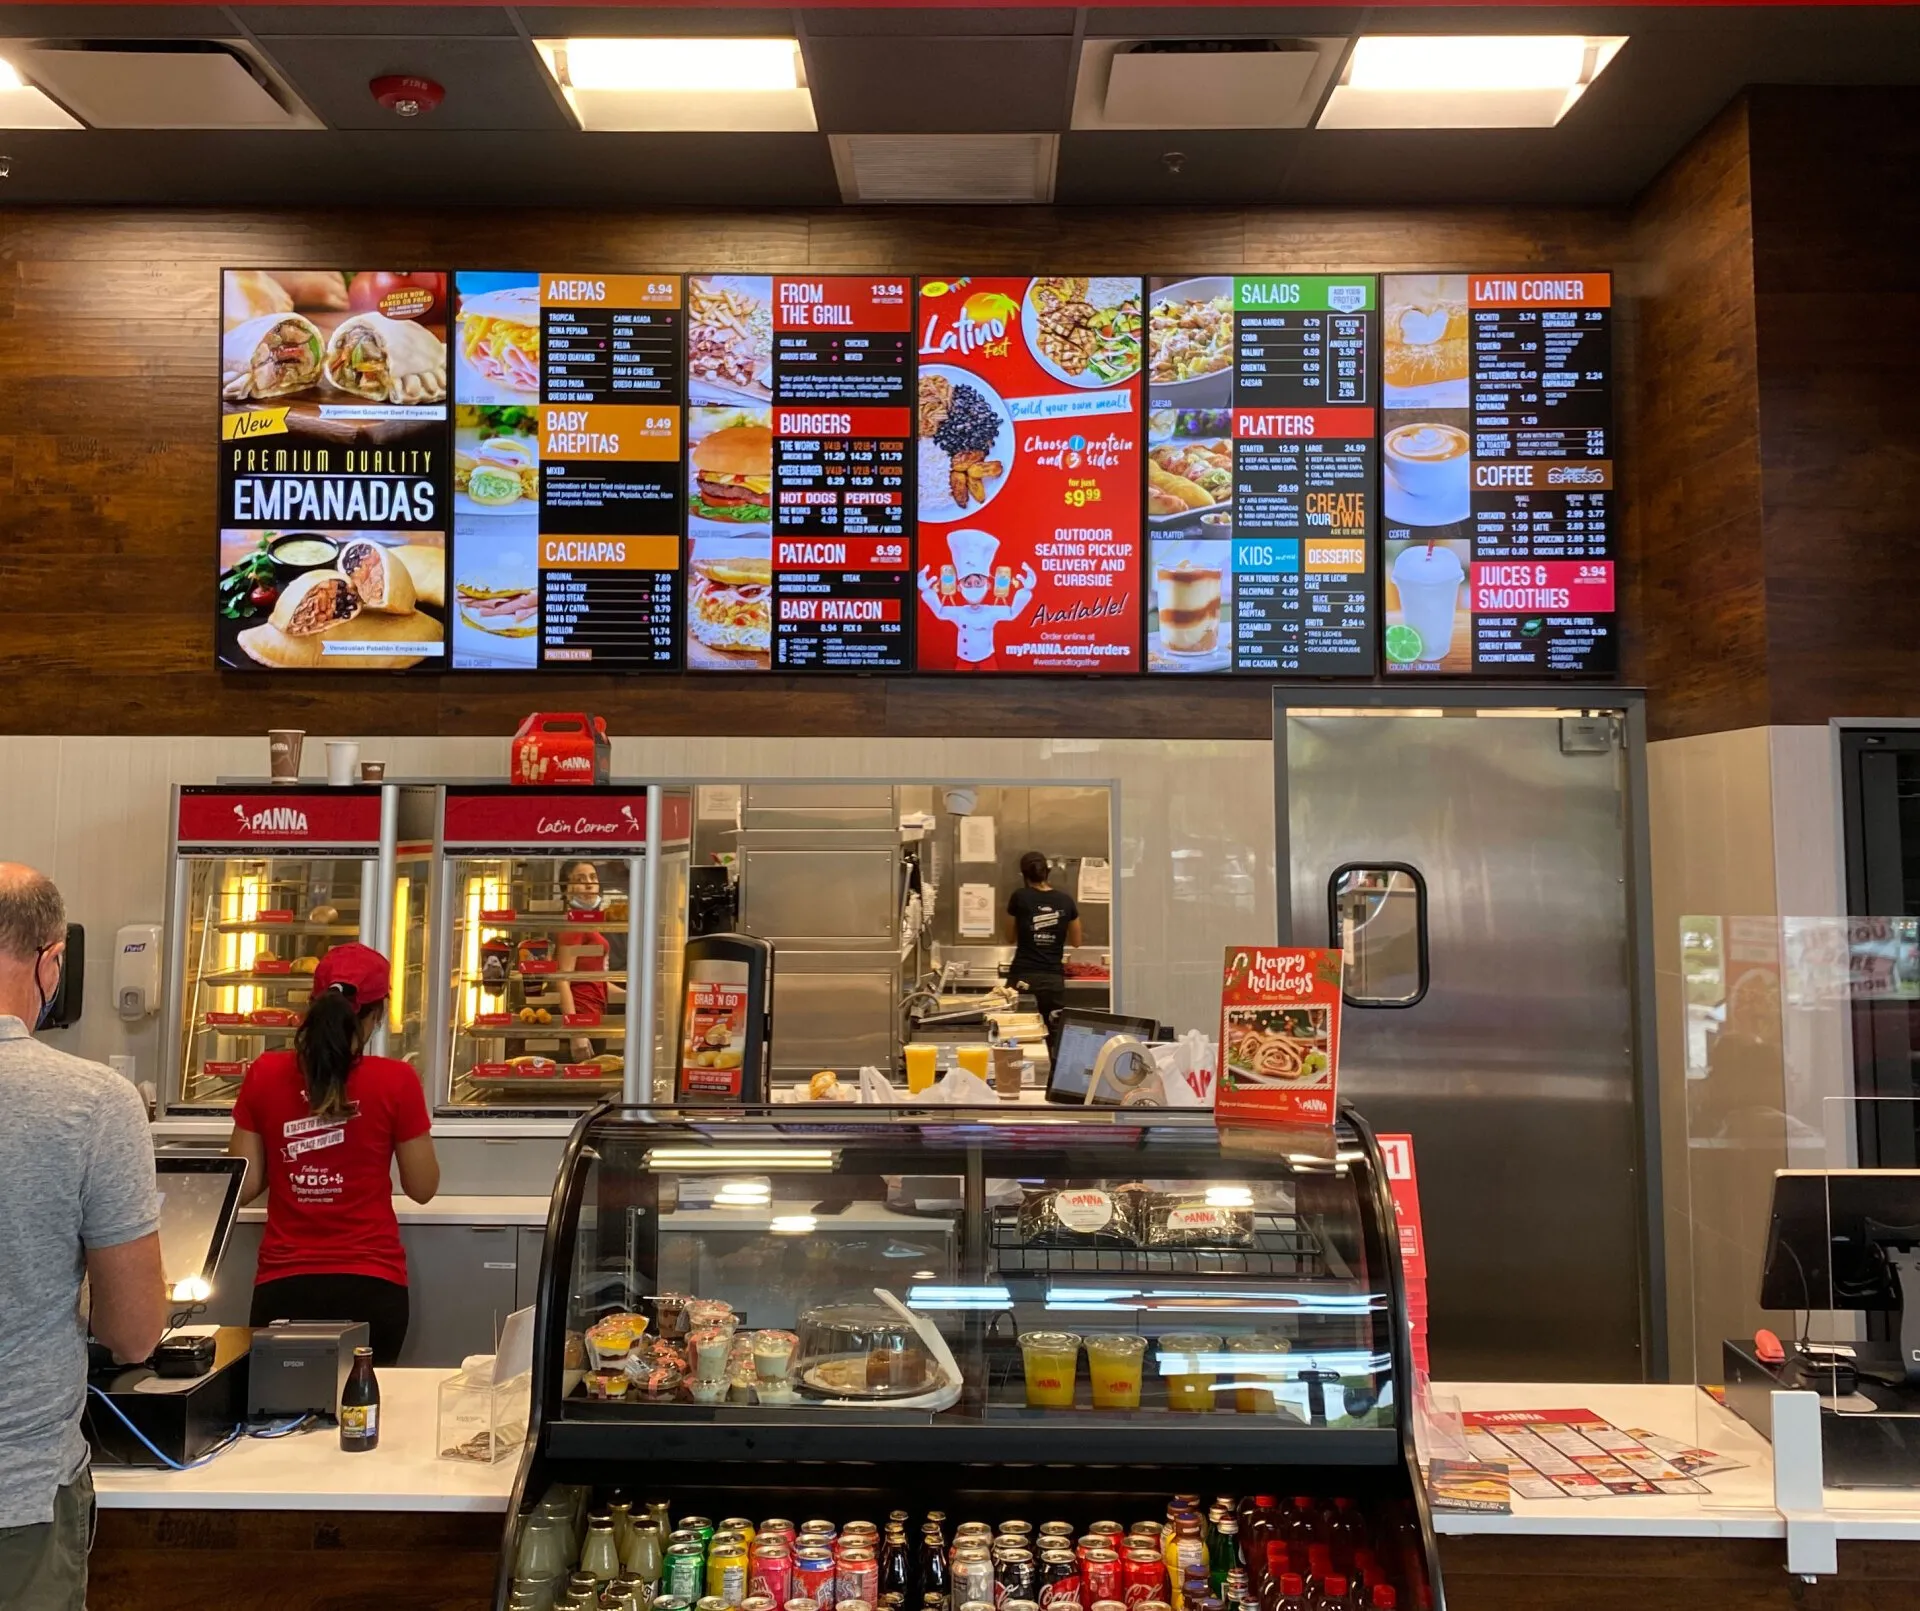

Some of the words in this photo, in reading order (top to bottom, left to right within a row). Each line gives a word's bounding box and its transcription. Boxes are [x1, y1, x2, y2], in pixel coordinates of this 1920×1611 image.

[548, 280, 605, 300] AREPAS
[647, 283, 673, 294] 6.94
[780, 283, 824, 304] FROM
[871, 284, 903, 296] 13.94
[1241, 283, 1300, 303] SALADS
[1475, 281, 1517, 301] LATIN
[1521, 280, 1584, 300] CORNER
[1333, 296, 1361, 304] PROTEIN
[548, 313, 575, 321] TROPICAL
[780, 304, 809, 325] THE
[812, 305, 854, 325] GRILL
[918, 307, 1005, 355] Latino
[1338, 327, 1355, 335] 2.50
[548, 340, 569, 348] PERICO
[984, 338, 1013, 358] Fest
[1338, 348, 1355, 356] 3.50
[1339, 381, 1354, 389] TUNA
[1338, 389, 1355, 397] 2.50
[1011, 400, 1042, 417] Build
[1045, 404, 1067, 415] your
[1072, 403, 1092, 411] own
[1096, 395, 1127, 409] meal!
[405, 409, 438, 417] Empanada
[233, 411, 273, 439] New
[547, 411, 588, 431] BABY
[646, 418, 671, 429] 8.49
[780, 413, 851, 434] BURGERS
[1239, 415, 1314, 436] PLATTERS
[547, 433, 619, 454] AREPITAS
[780, 441, 793, 451] THE
[793, 441, 820, 451] WORKS
[1024, 435, 1069, 453] Choose
[1086, 432, 1133, 455] protein
[1239, 444, 1264, 453] STARTER
[1278, 444, 1300, 453] 12.99
[1344, 444, 1366, 453] 24.99
[234, 449, 329, 471] PREMIUM
[347, 450, 432, 473] QUALITY
[1037, 450, 1064, 470] and
[1069, 452, 1080, 469] 3
[1087, 450, 1119, 470] sides
[546, 466, 565, 475] MIXED
[1476, 466, 1533, 486] COFFEE
[1068, 478, 1079, 487] for
[1080, 478, 1096, 488] just
[1548, 473, 1604, 483] ESPRESSO
[1239, 485, 1252, 493] FULL
[1277, 484, 1299, 493] 29.99
[234, 479, 434, 521] EMPANADAS
[780, 493, 802, 504] HOT
[805, 492, 837, 504] DOGS
[845, 493, 892, 504] PEPITOS
[1306, 493, 1364, 513] CREATE
[844, 507, 862, 516] STEAK
[1305, 513, 1331, 525] YOUR
[1330, 511, 1365, 528] OWN
[1389, 529, 1411, 538] COFFEE
[1533, 523, 1550, 532] LATTE
[1054, 528, 1112, 541] OUTDOOR
[1151, 531, 1162, 539] FULL
[1163, 531, 1184, 539] PLATTER
[546, 541, 626, 562] CACHAPAS
[779, 543, 846, 564] PATACON
[876, 545, 902, 556] 8.99
[1034, 543, 1085, 556] SEATING
[1239, 546, 1273, 566] KIDS
[1308, 549, 1362, 564] DESSERTS
[1042, 559, 1097, 571] DELIVERY
[1100, 559, 1125, 571] AND
[546, 572, 572, 580] ORIGINAL
[1478, 566, 1531, 586] JUICES
[1535, 565, 1547, 586] &
[1579, 566, 1606, 577] 3.94
[842, 574, 860, 582] STEAK
[1054, 574, 1113, 587] CURBSIDE
[1304, 582, 1320, 590] CAKE
[566, 594, 584, 602] STEAK
[1312, 595, 1328, 603] SLICE
[1479, 588, 1569, 609] SMOOTHIES
[781, 601, 818, 619] BABY
[821, 601, 882, 619] PATACON
[1030, 592, 1130, 628] Available!
[1312, 605, 1331, 613] WHOLE
[778, 624, 792, 632] PICK
[1282, 624, 1299, 632] 4.24
[1305, 619, 1323, 627] SHOTS
[1040, 633, 1061, 641] Order
[1063, 632, 1086, 641] online
[1087, 633, 1095, 641] at
[1005, 643, 1130, 657] myPANNA.com/orders
[1282, 645, 1299, 653] 4.24
[562, 756, 590, 769] PANNA
[252, 807, 308, 830] PANNA
[537, 817, 571, 834] Latin
[575, 817, 619, 834] Corner
[1255, 950, 1305, 974] happy
[1247, 970, 1314, 995] holidays
[695, 994, 714, 1006] GRAB
[725, 995, 738, 1007] GO
[1302, 1099, 1328, 1111] PANNA
[290, 1122, 307, 1130] TASTE
[289, 1144, 299, 1153] THE
[300, 1141, 315, 1151] PLACE
[1072, 1194, 1103, 1205] PANNA
[1184, 1212, 1216, 1223] PANNA
